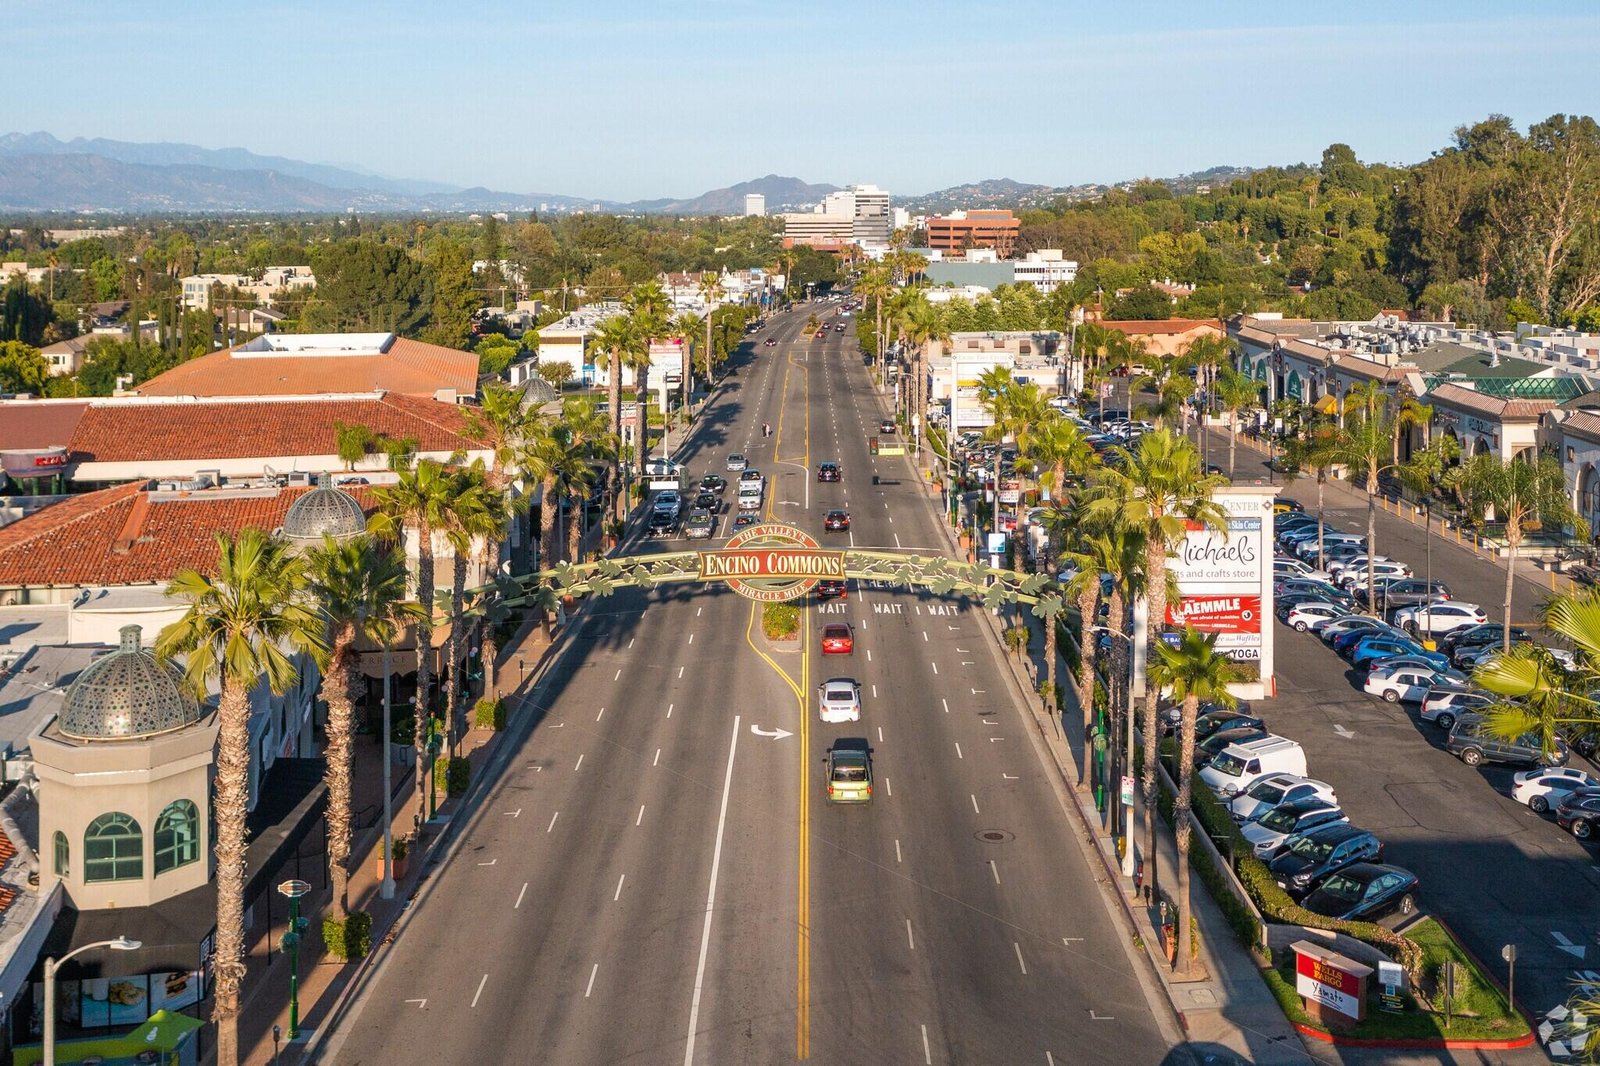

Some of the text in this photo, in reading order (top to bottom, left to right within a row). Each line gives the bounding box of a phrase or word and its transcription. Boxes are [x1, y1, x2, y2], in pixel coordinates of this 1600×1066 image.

[1222, 499, 1259, 512] CENTER
[1232, 520, 1243, 530] Skin
[1244, 520, 1261, 530] Center
[739, 526, 807, 543] THE VALLEY'S
[706, 552, 840, 576] ENCINO COMMONS
[1186, 569, 1203, 578] and
[1206, 569, 1230, 578] crafts
[1233, 570, 1255, 578] store
[738, 584, 808, 600] MIRACLE MILE
[818, 603, 847, 614] WAIT
[874, 603, 902, 614] WAIT
[927, 604, 959, 616] WAIT
[1231, 649, 1259, 658] YOGA
[1312, 961, 1343, 980] WELLS
[1313, 970, 1343, 988] FARGO
